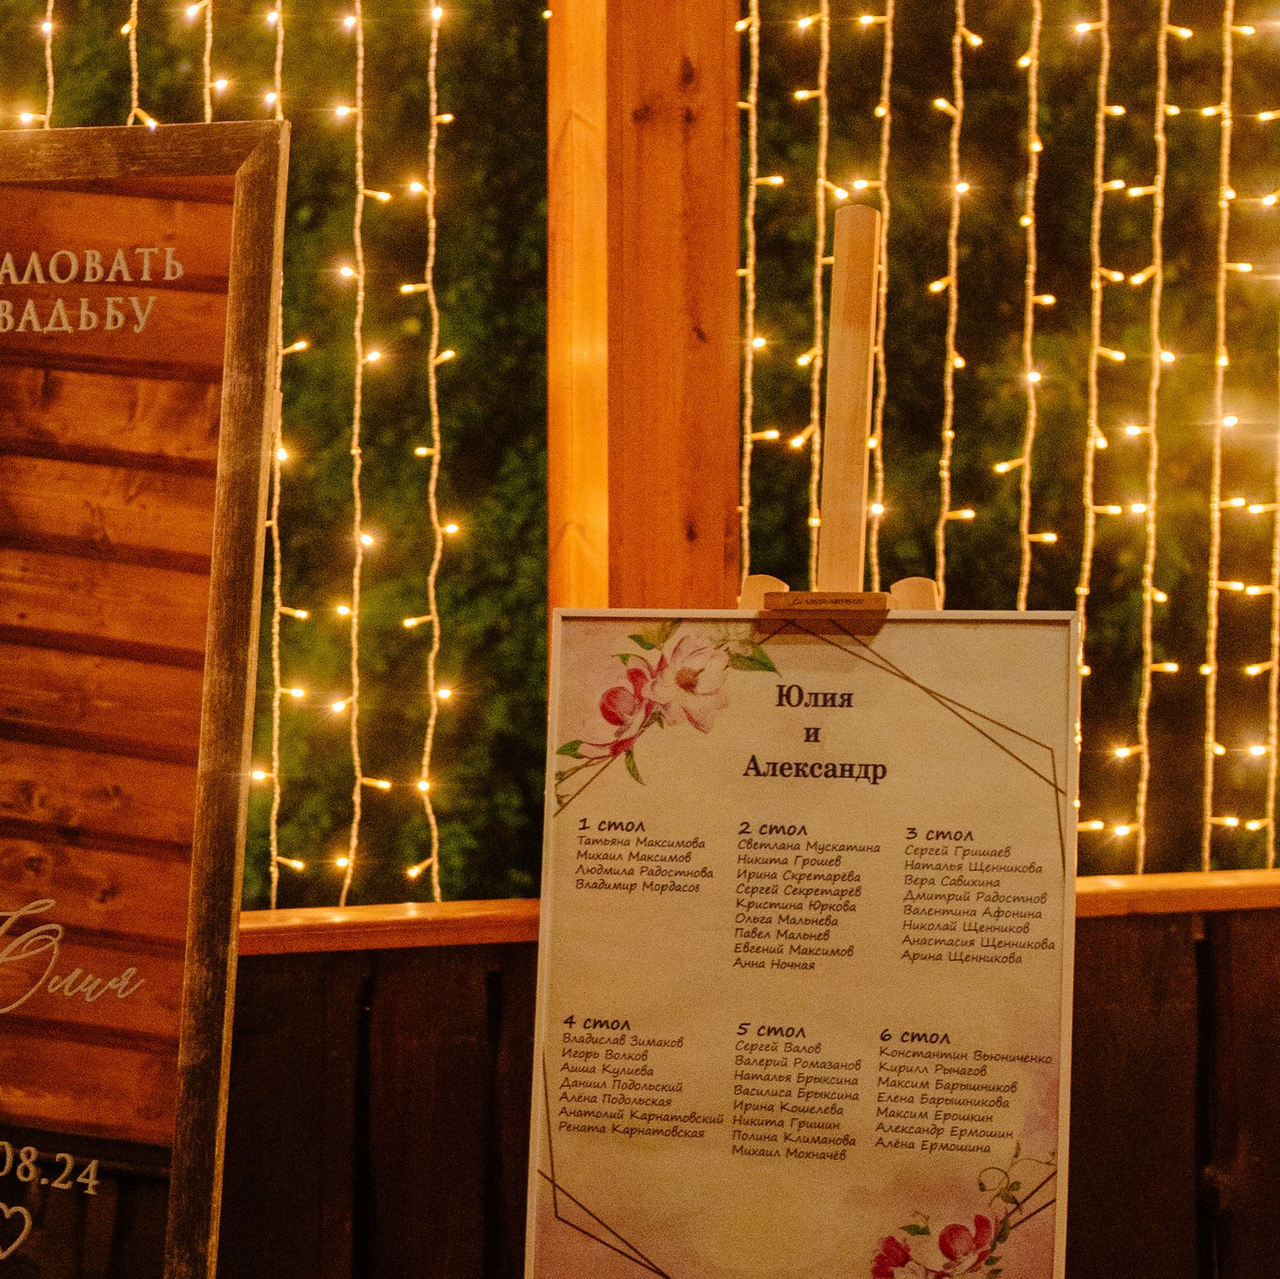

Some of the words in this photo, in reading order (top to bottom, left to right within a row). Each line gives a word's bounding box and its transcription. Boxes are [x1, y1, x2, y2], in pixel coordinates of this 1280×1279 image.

[775, 684, 853, 708] Юлия
[805, 727, 820, 743] и
[743, 755, 887, 785] Александр
[578, 818, 589, 830] 1
[598, 820, 645, 832] стол
[738, 822, 751, 835] 2
[759, 824, 807, 836] стол
[906, 828, 917, 839] 3
[926, 829, 974, 841] стол
[578, 836, 630, 846] Татьяна
[636, 837, 705, 848] Максимова
[738, 838, 800, 850] Светлана
[806, 841, 880, 854] Мускатина
[576, 850, 623, 860] Михаил
[628, 851, 692, 862] Максимов
[905, 845, 948, 858] Сергей
[954, 846, 1011, 859] Гришаев
[738, 855, 788, 865] Никита
[794, 855, 842, 868] Грошев
[905, 860, 963, 871] Наталья
[969, 862, 1043, 874] Щенникова
[575, 864, 634, 876] Людмила
[640, 866, 713, 878] Радостнова
[737, 869, 777, 882] Ирина
[576, 879, 637, 894] Владимир
[642, 881, 700, 894] Мордасов
[904, 875, 935, 887] Вера
[941, 875, 1000, 887] Савихина
[736, 884, 778, 897] Сергей
[903, 890, 970, 904] Дмитрий
[976, 892, 1047, 904] Радостнов
[736, 898, 803, 912] Кристина
[809, 900, 856, 913] Юркова
[904, 905, 976, 916] Валентина
[982, 907, 1042, 920] Афонина
[735, 913, 772, 924] Ольга
[778, 914, 838, 926] Мальнева
[735, 928, 770, 939] Павел
[776, 929, 830, 940] Мальнев
[902, 920, 956, 931] Николай
[963, 922, 1030, 934] Щенников
[735, 942, 784, 954] Евгений
[789, 945, 854, 956] Максимов
[902, 935, 975, 946] Анастасия
[981, 937, 1055, 949] Щенникова
[733, 958, 765, 968] Анна
[771, 959, 815, 969] Ночная
[901, 950, 942, 964] Арина
[949, 951, 1022, 964] Щенникова
[563, 1015, 576, 1028] 4
[583, 1018, 631, 1030] стол
[737, 1023, 751, 1035] 5
[757, 1025, 806, 1038] стол
[880, 1029, 892, 1042] 6
[901, 1031, 950, 1044] стол
[563, 1033, 626, 1045] Владислав
[630, 1035, 684, 1048] Зимаков
[735, 1040, 778, 1054] Сергей
[784, 1042, 822, 1054] Валов
[562, 1048, 599, 1061] Игорь
[605, 1049, 648, 1061] Волков
[879, 1047, 968, 1060] Константин
[973, 1050, 1052, 1064] Вьюниченко
[735, 1055, 788, 1070] Валерий
[794, 1058, 862, 1070] Ромазанов
[879, 1062, 929, 1075] Кирилл
[935, 1064, 987, 1076] Рычагов
[602, 1064, 653, 1077] Кулиева
[559, 1077, 607, 1089] Даниил
[612, 1079, 683, 1092] Подольский
[734, 1070, 791, 1082] Наталья
[796, 1073, 858, 1086] Брыксина
[877, 1077, 929, 1089] Максим
[935, 1079, 1017, 1093] Барышников
[559, 1092, 597, 1103] Алёна
[602, 1094, 671, 1106] Подольская
[734, 1085, 792, 1097] Василиса
[797, 1088, 859, 1101] Брыксина
[877, 1092, 914, 1104] Елена
[920, 1094, 1010, 1108] Барышникова
[733, 1100, 774, 1114] Ирина
[780, 1102, 844, 1115] Кошелева
[876, 1107, 928, 1120] Максим
[935, 1110, 993, 1122] Ерошкин
[559, 1107, 624, 1119] Анатолий
[630, 1110, 724, 1124] Карнатовский
[733, 1115, 784, 1127] Никита
[790, 1118, 840, 1131] Гришин
[559, 1122, 606, 1133] Рената
[612, 1124, 705, 1139] Карнатовская
[875, 1123, 944, 1137] Александр
[950, 1126, 1013, 1138] Ермошин
[732, 1130, 778, 1142] Полина
[784, 1132, 856, 1146] Климанова
[875, 1137, 915, 1149] Алёна
[921, 1140, 990, 1153] Ермошина
[732, 1145, 780, 1157] Михаил
